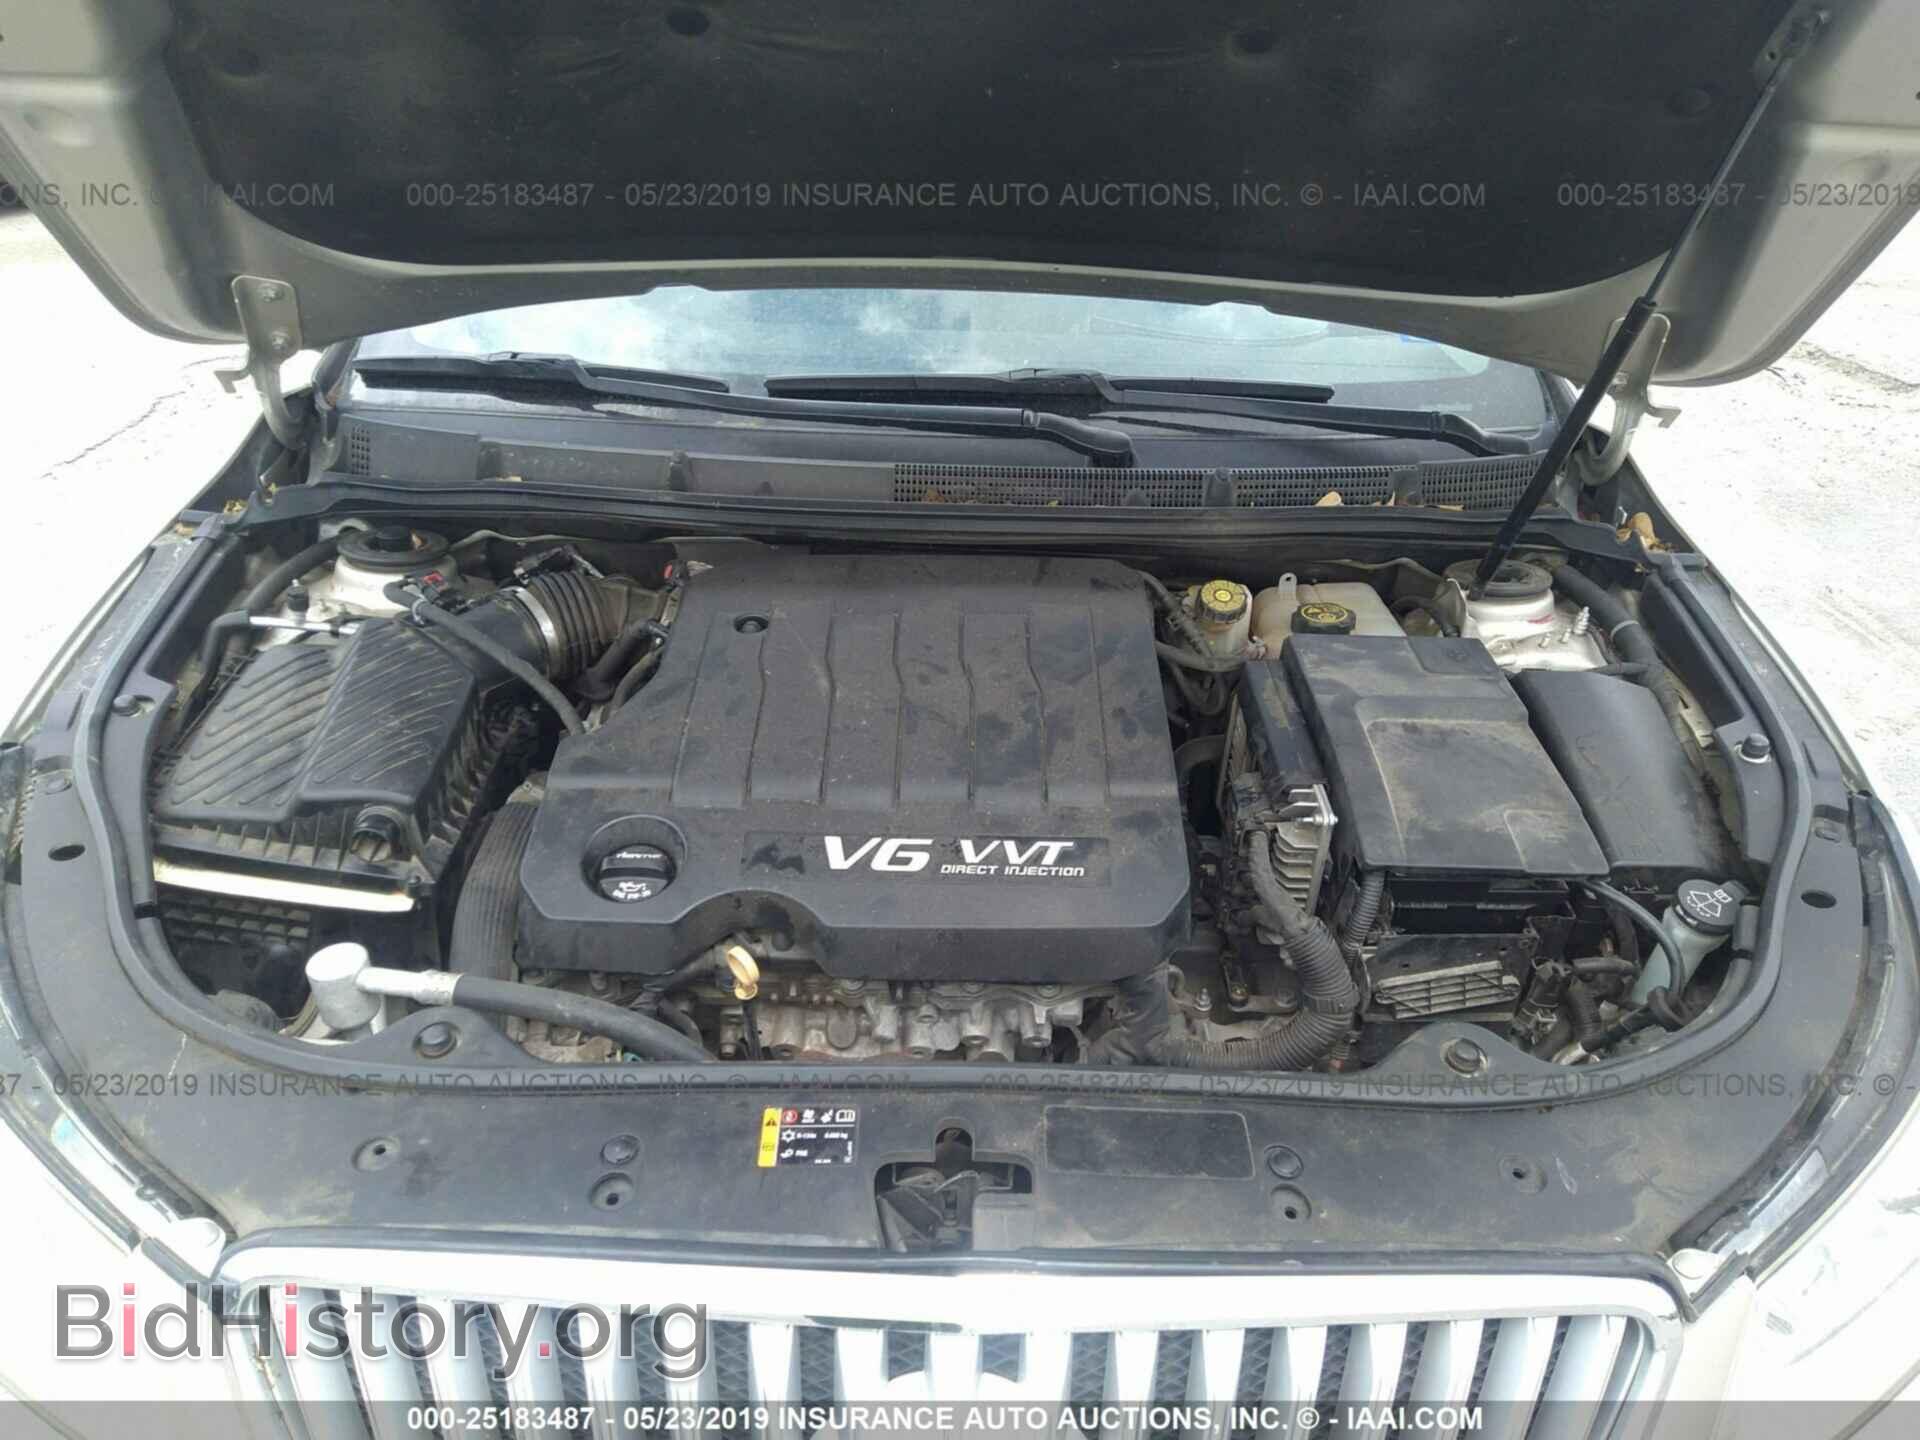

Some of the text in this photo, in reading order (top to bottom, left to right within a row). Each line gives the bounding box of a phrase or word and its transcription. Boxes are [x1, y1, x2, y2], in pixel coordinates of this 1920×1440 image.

[823, 835, 1074, 872] V6 VVT
[940, 864, 1085, 877] DIRECT INJECTION
